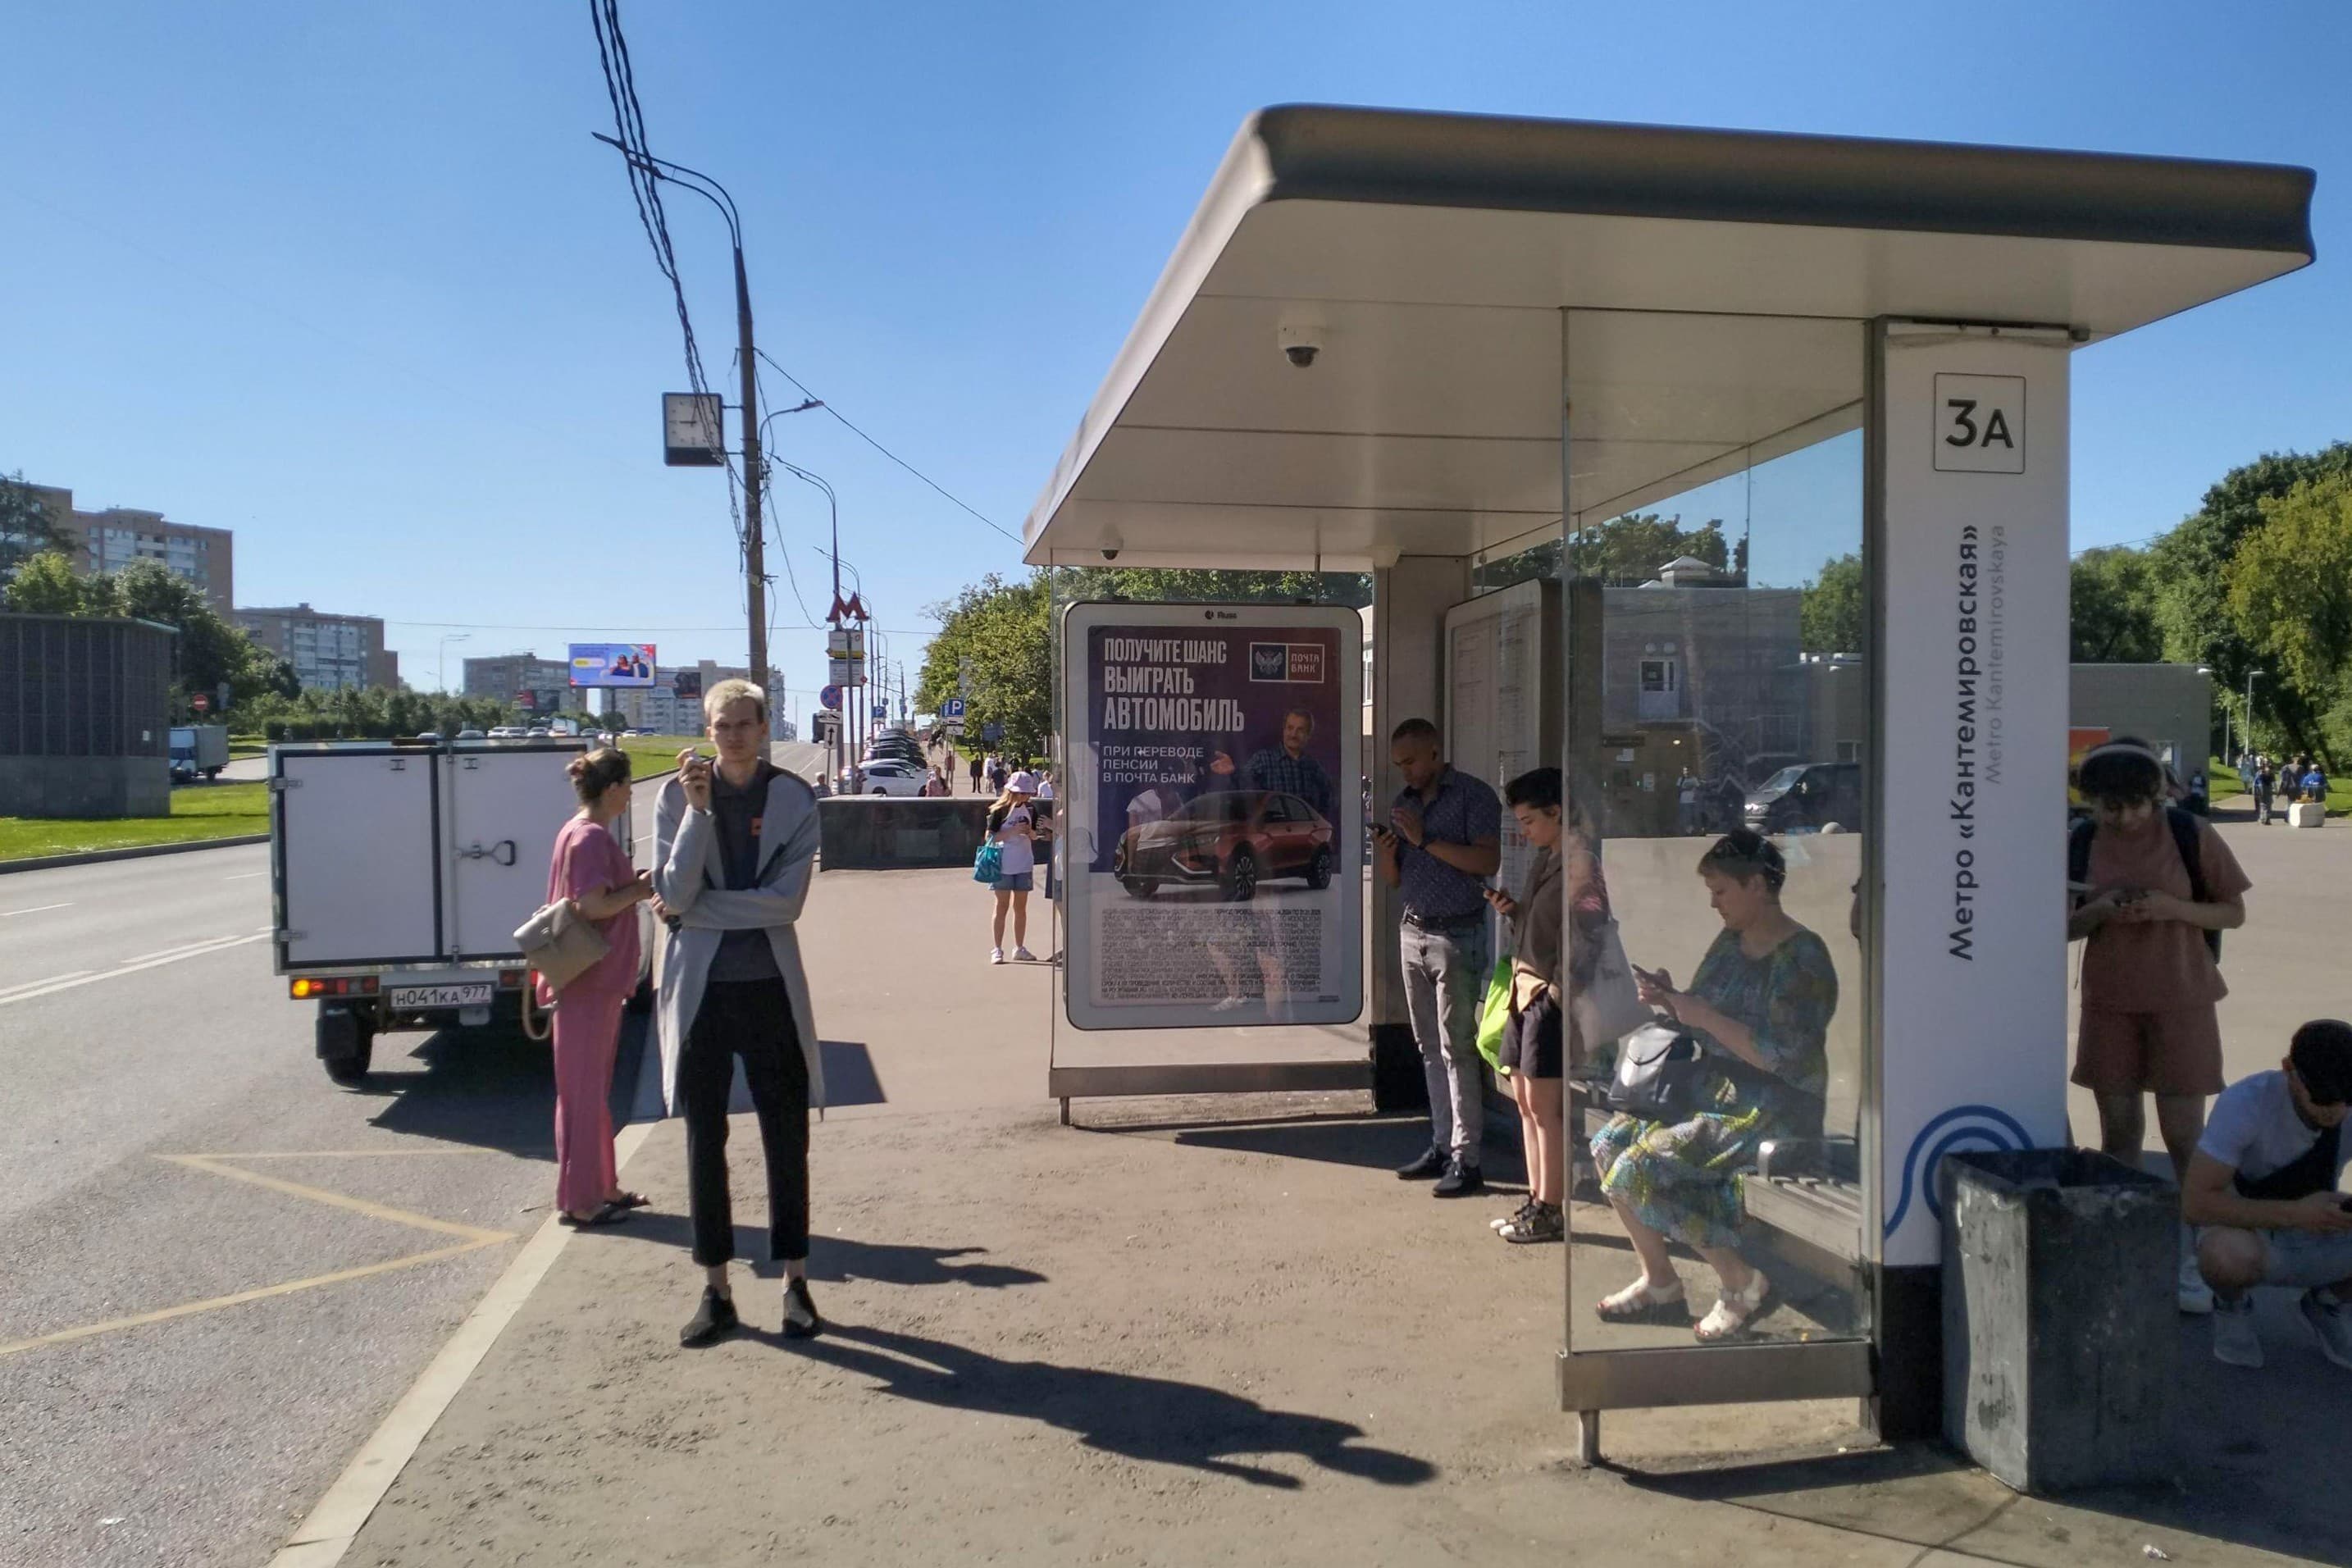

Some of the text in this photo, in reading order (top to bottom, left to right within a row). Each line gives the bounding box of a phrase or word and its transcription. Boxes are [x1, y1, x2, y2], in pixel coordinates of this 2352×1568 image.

[1945, 399, 2014, 449] 3А
[1104, 637, 1227, 664] ПОЛУЧИТЕ ШАНС
[1291, 653, 1320, 663] ПОЧТА
[1985, 525, 2008, 785] Metro Kantemirovskaya
[1291, 663, 1315, 673] БАНК
[1104, 666, 1195, 695] ВЫИГРАТЬ
[951, 700, 963, 714] P
[1104, 697, 1245, 732] АВТОМОБИЛЬ
[1103, 745, 1205, 759] ПРИ ПЕРЕВОДЕ
[1949, 525, 1981, 961] Метро «Кантемировская»
[1103, 759, 1159, 770] ПЕНСИИ
[1103, 772, 1195, 784] В ПОЧТА БАНК
